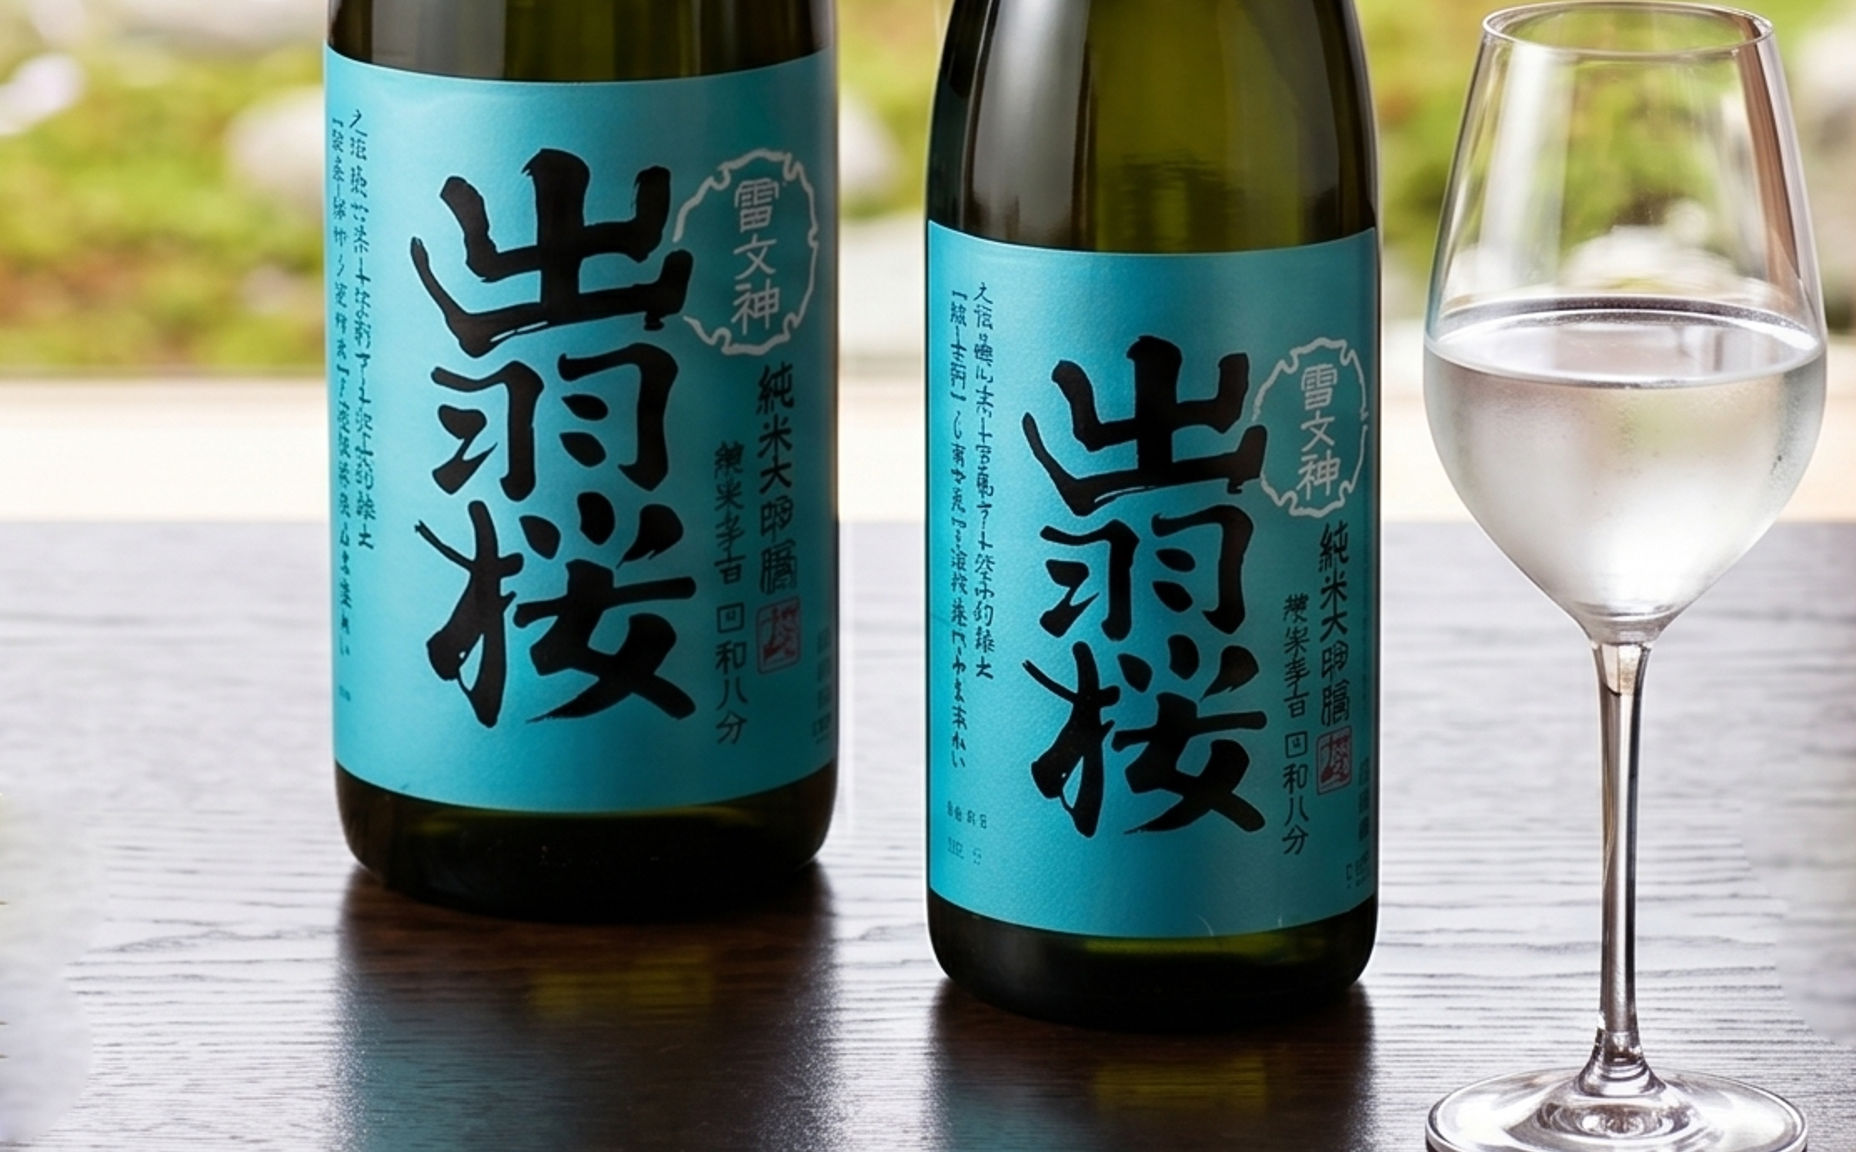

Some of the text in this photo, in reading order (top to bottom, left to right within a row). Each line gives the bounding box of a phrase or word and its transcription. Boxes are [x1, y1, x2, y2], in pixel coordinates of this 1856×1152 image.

[411, 148, 698, 728] 出羽桜
[1022, 334, 1268, 838] 出羽桜
